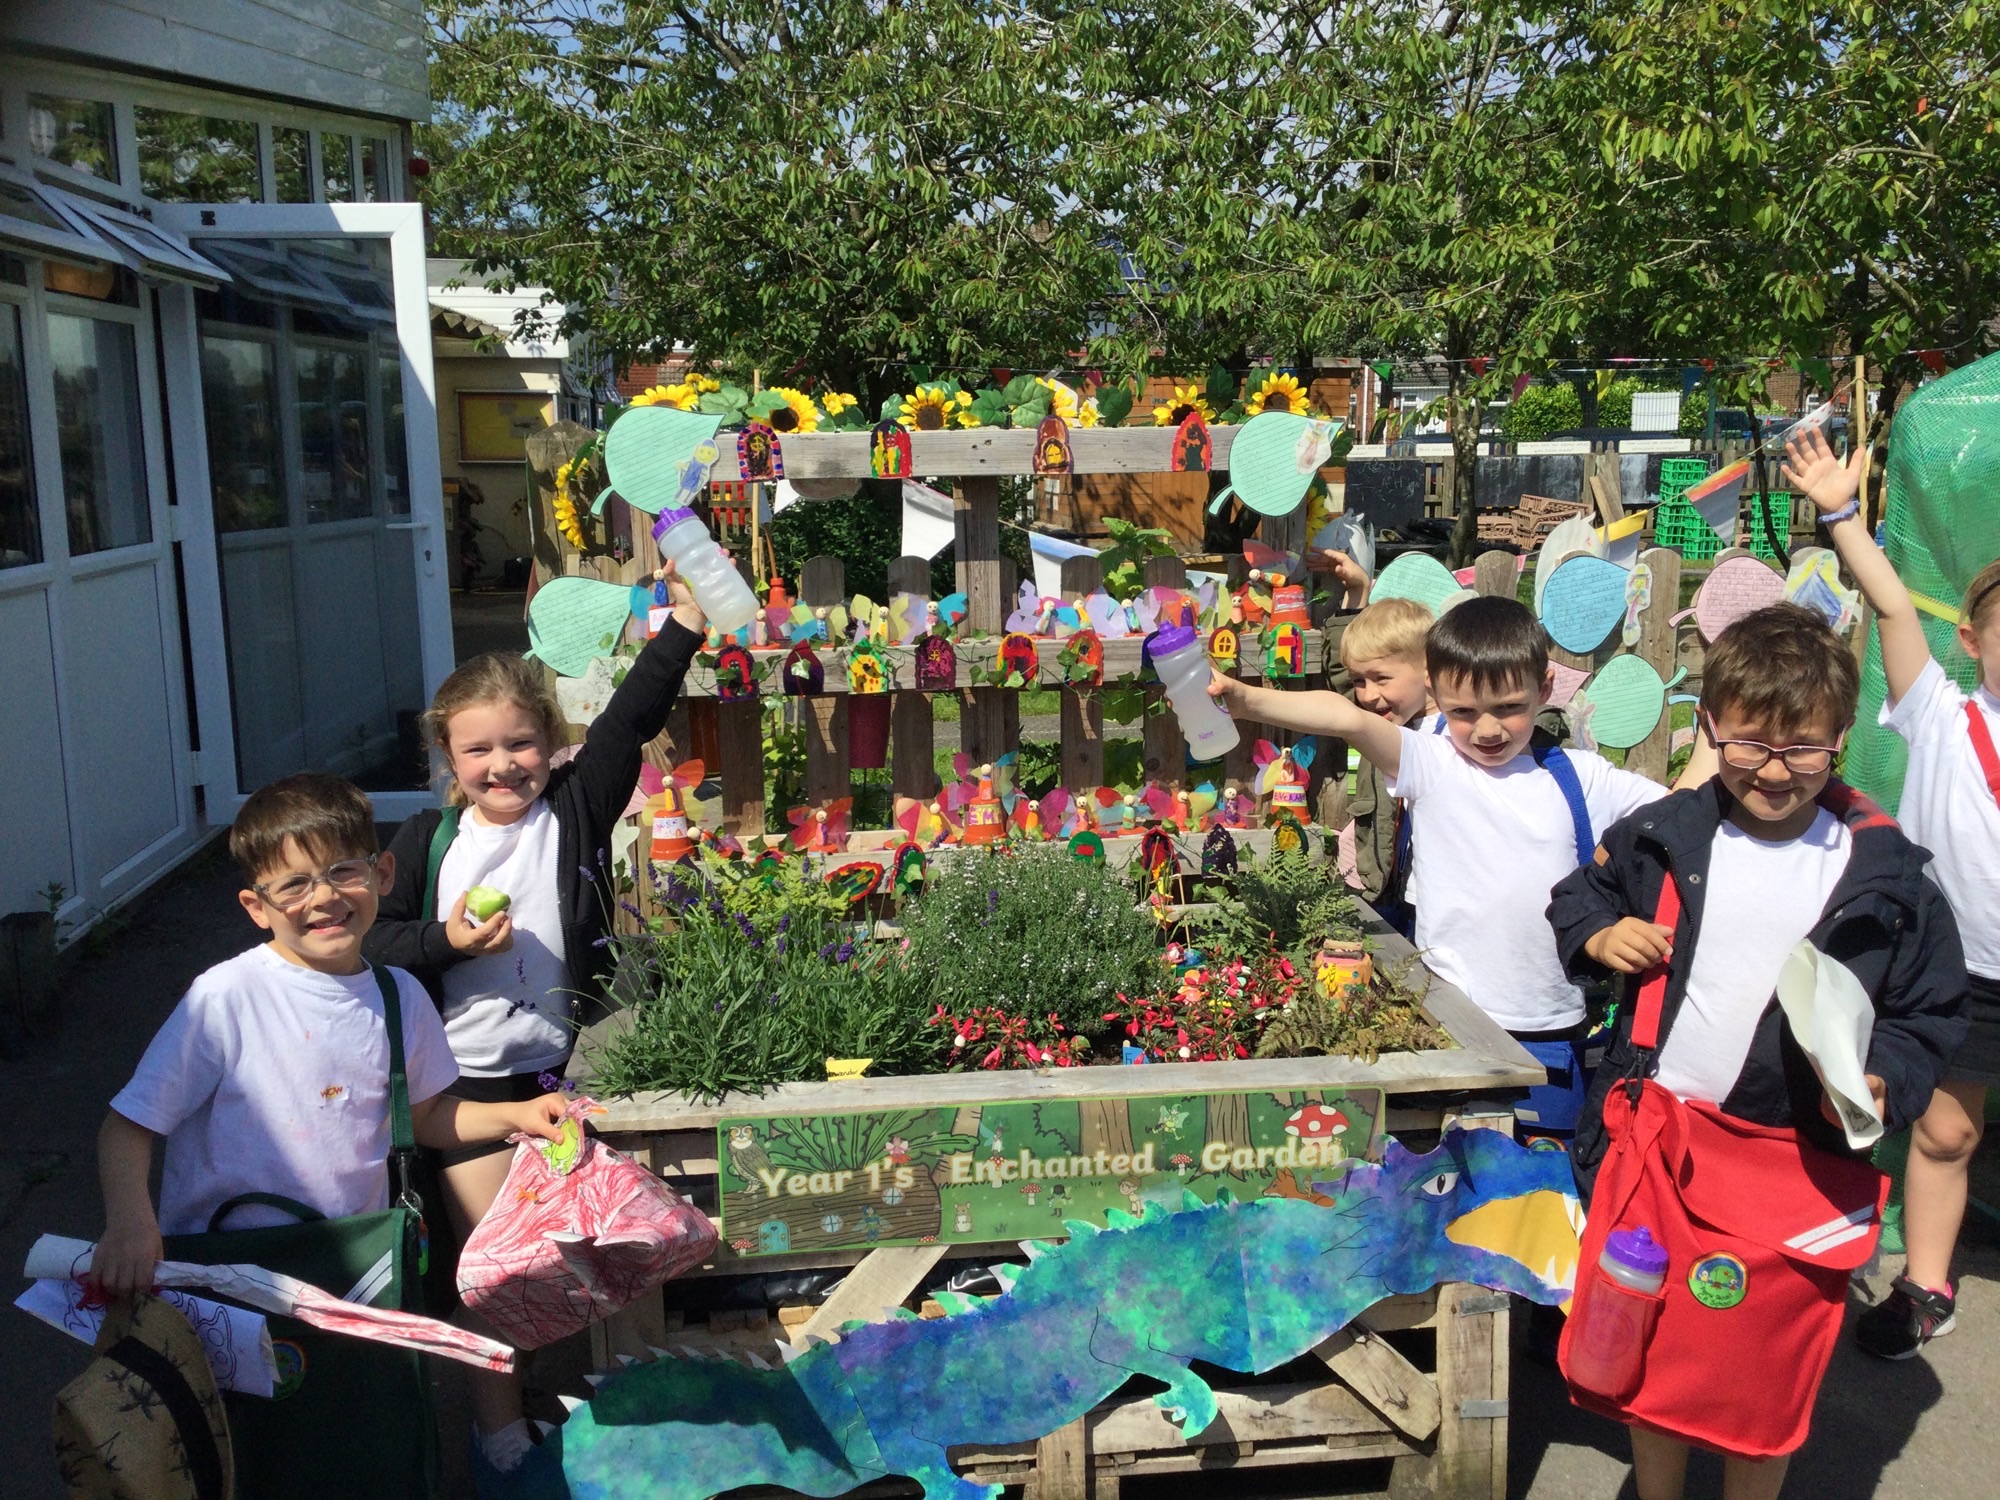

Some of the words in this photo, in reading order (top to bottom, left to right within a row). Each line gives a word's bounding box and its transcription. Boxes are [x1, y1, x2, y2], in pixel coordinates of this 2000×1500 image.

[320, 1086, 343, 1098] WOW
[758, 1168, 852, 1198] Year
[864, 1157, 914, 1190] 1's
[951, 1142, 1155, 1183] Enchanted
[1202, 1136, 1342, 1171] Garden
